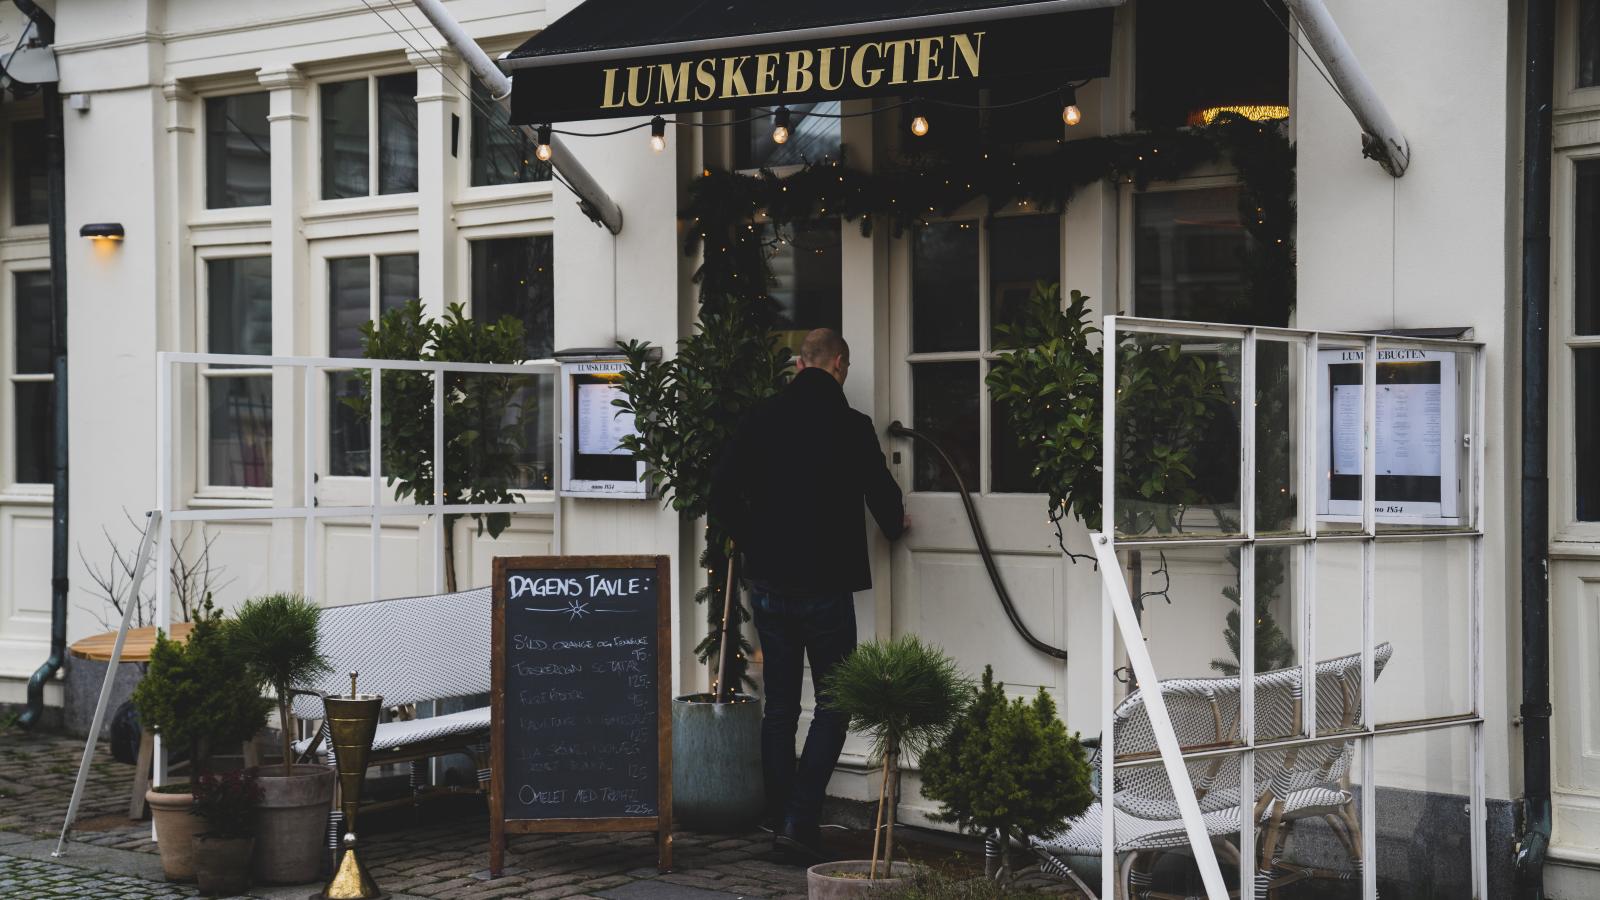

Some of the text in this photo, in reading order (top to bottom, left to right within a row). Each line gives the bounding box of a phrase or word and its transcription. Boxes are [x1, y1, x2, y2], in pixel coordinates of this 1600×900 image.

[600, 31, 986, 109] LUMSKEBUGTEN
[1342, 349, 1426, 361] LUMEBUGTEN
[508, 575, 583, 599] DAGENS
